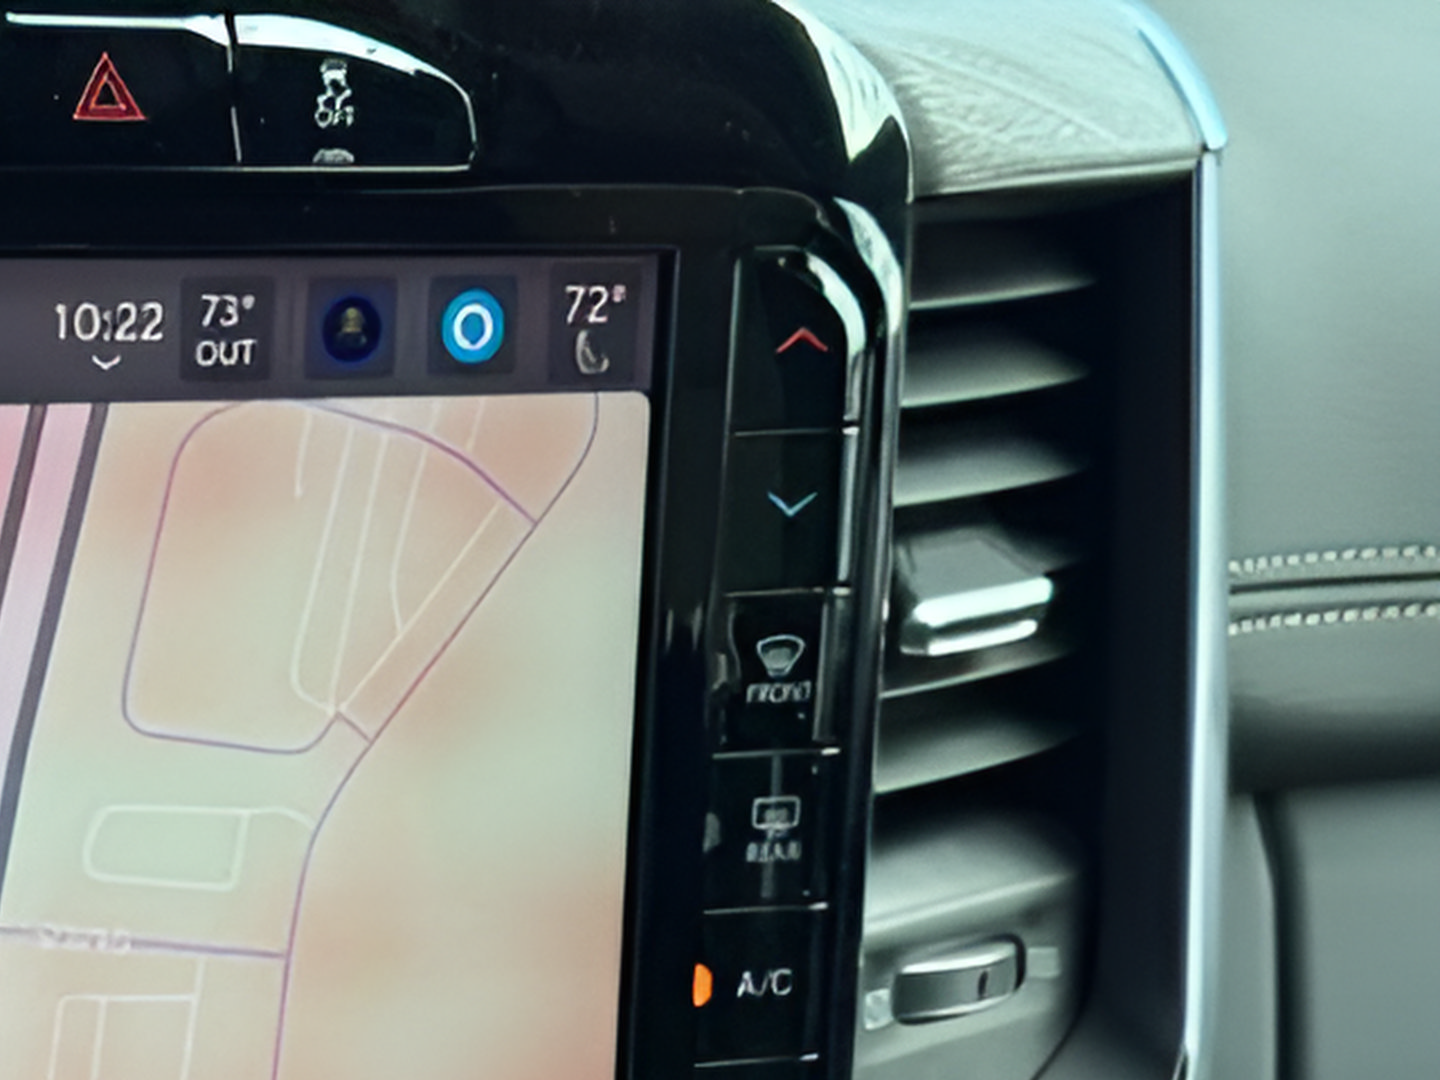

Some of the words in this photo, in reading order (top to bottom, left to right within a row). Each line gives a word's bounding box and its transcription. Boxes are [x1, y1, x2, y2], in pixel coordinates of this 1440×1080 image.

[56, 302, 164, 341] 10:22
[201, 294, 256, 327] 73°
[565, 285, 627, 325] 72°
[195, 339, 257, 367] OUT
[737, 968, 793, 998] A/C
